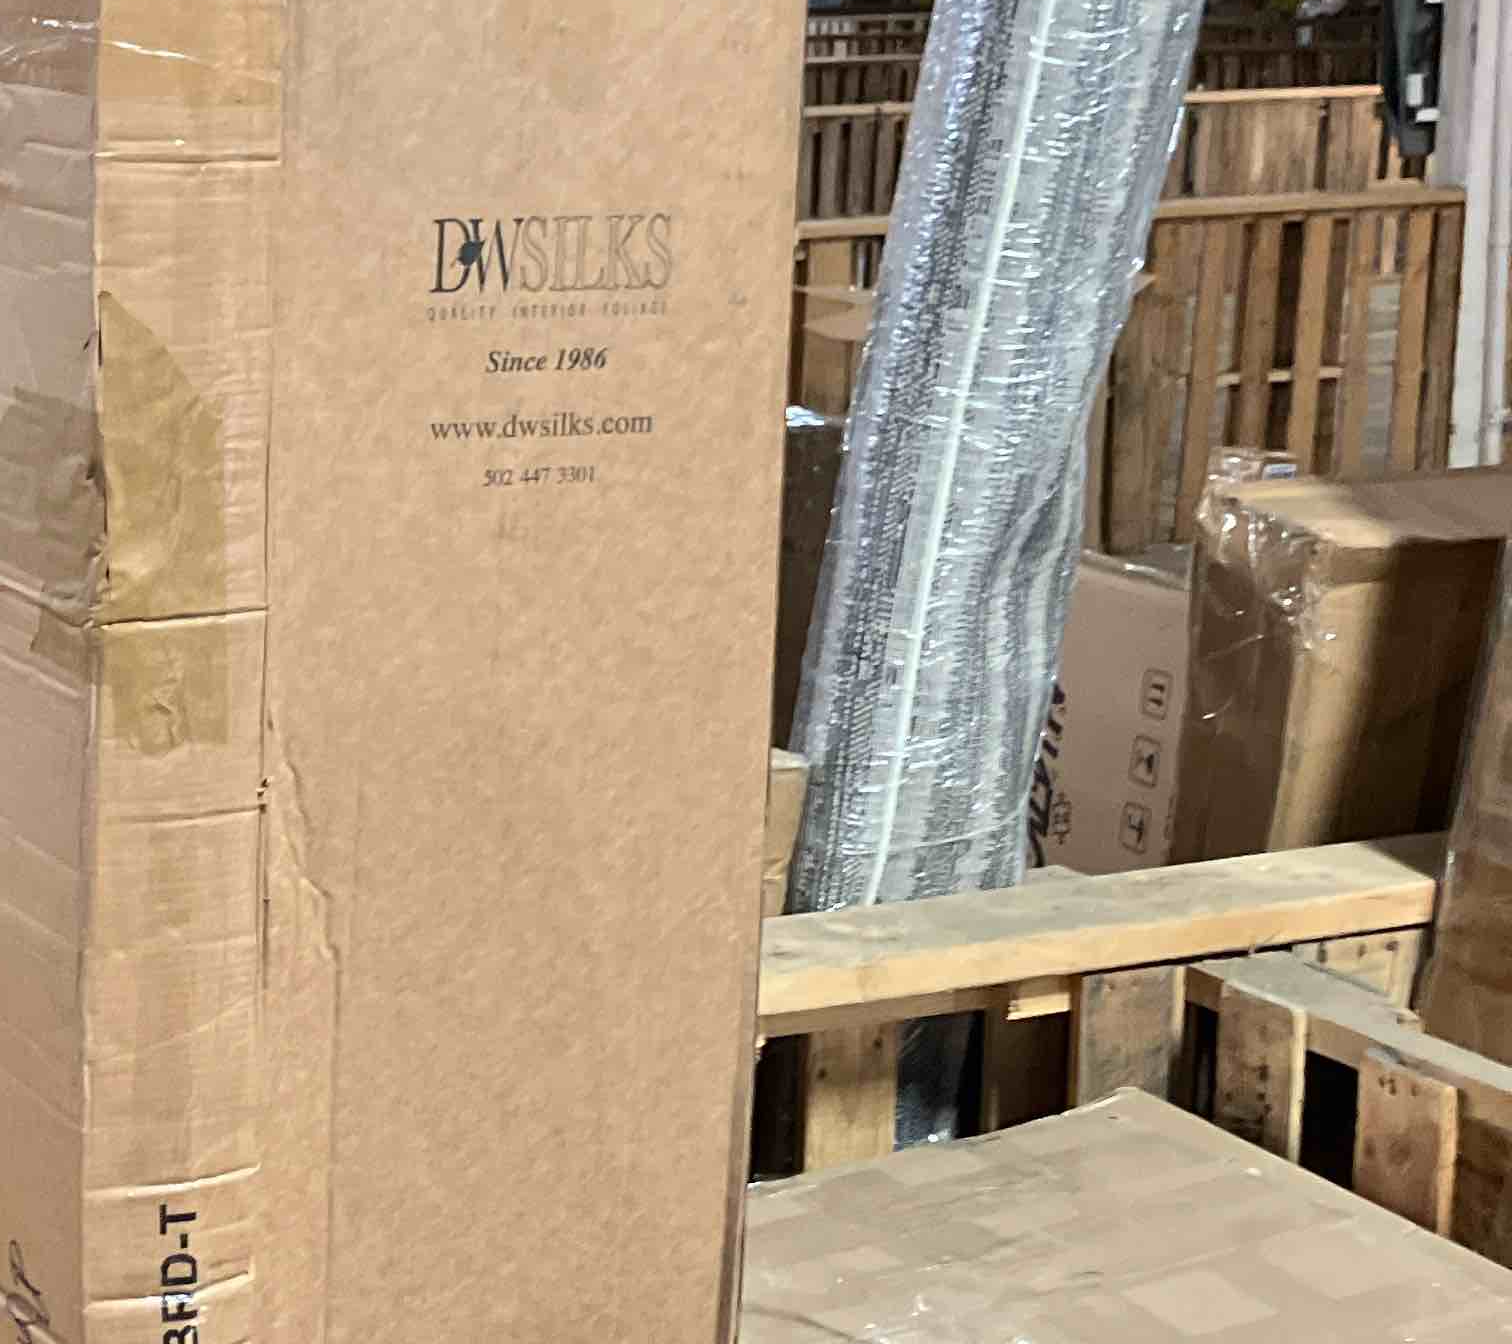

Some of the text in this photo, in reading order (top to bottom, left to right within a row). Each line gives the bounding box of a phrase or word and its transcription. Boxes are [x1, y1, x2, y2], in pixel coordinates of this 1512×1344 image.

[485, 346, 609, 374] Since 1986
[430, 412, 654, 441] www.dwsilks.com
[481, 464, 596, 488] 502 447 3301
